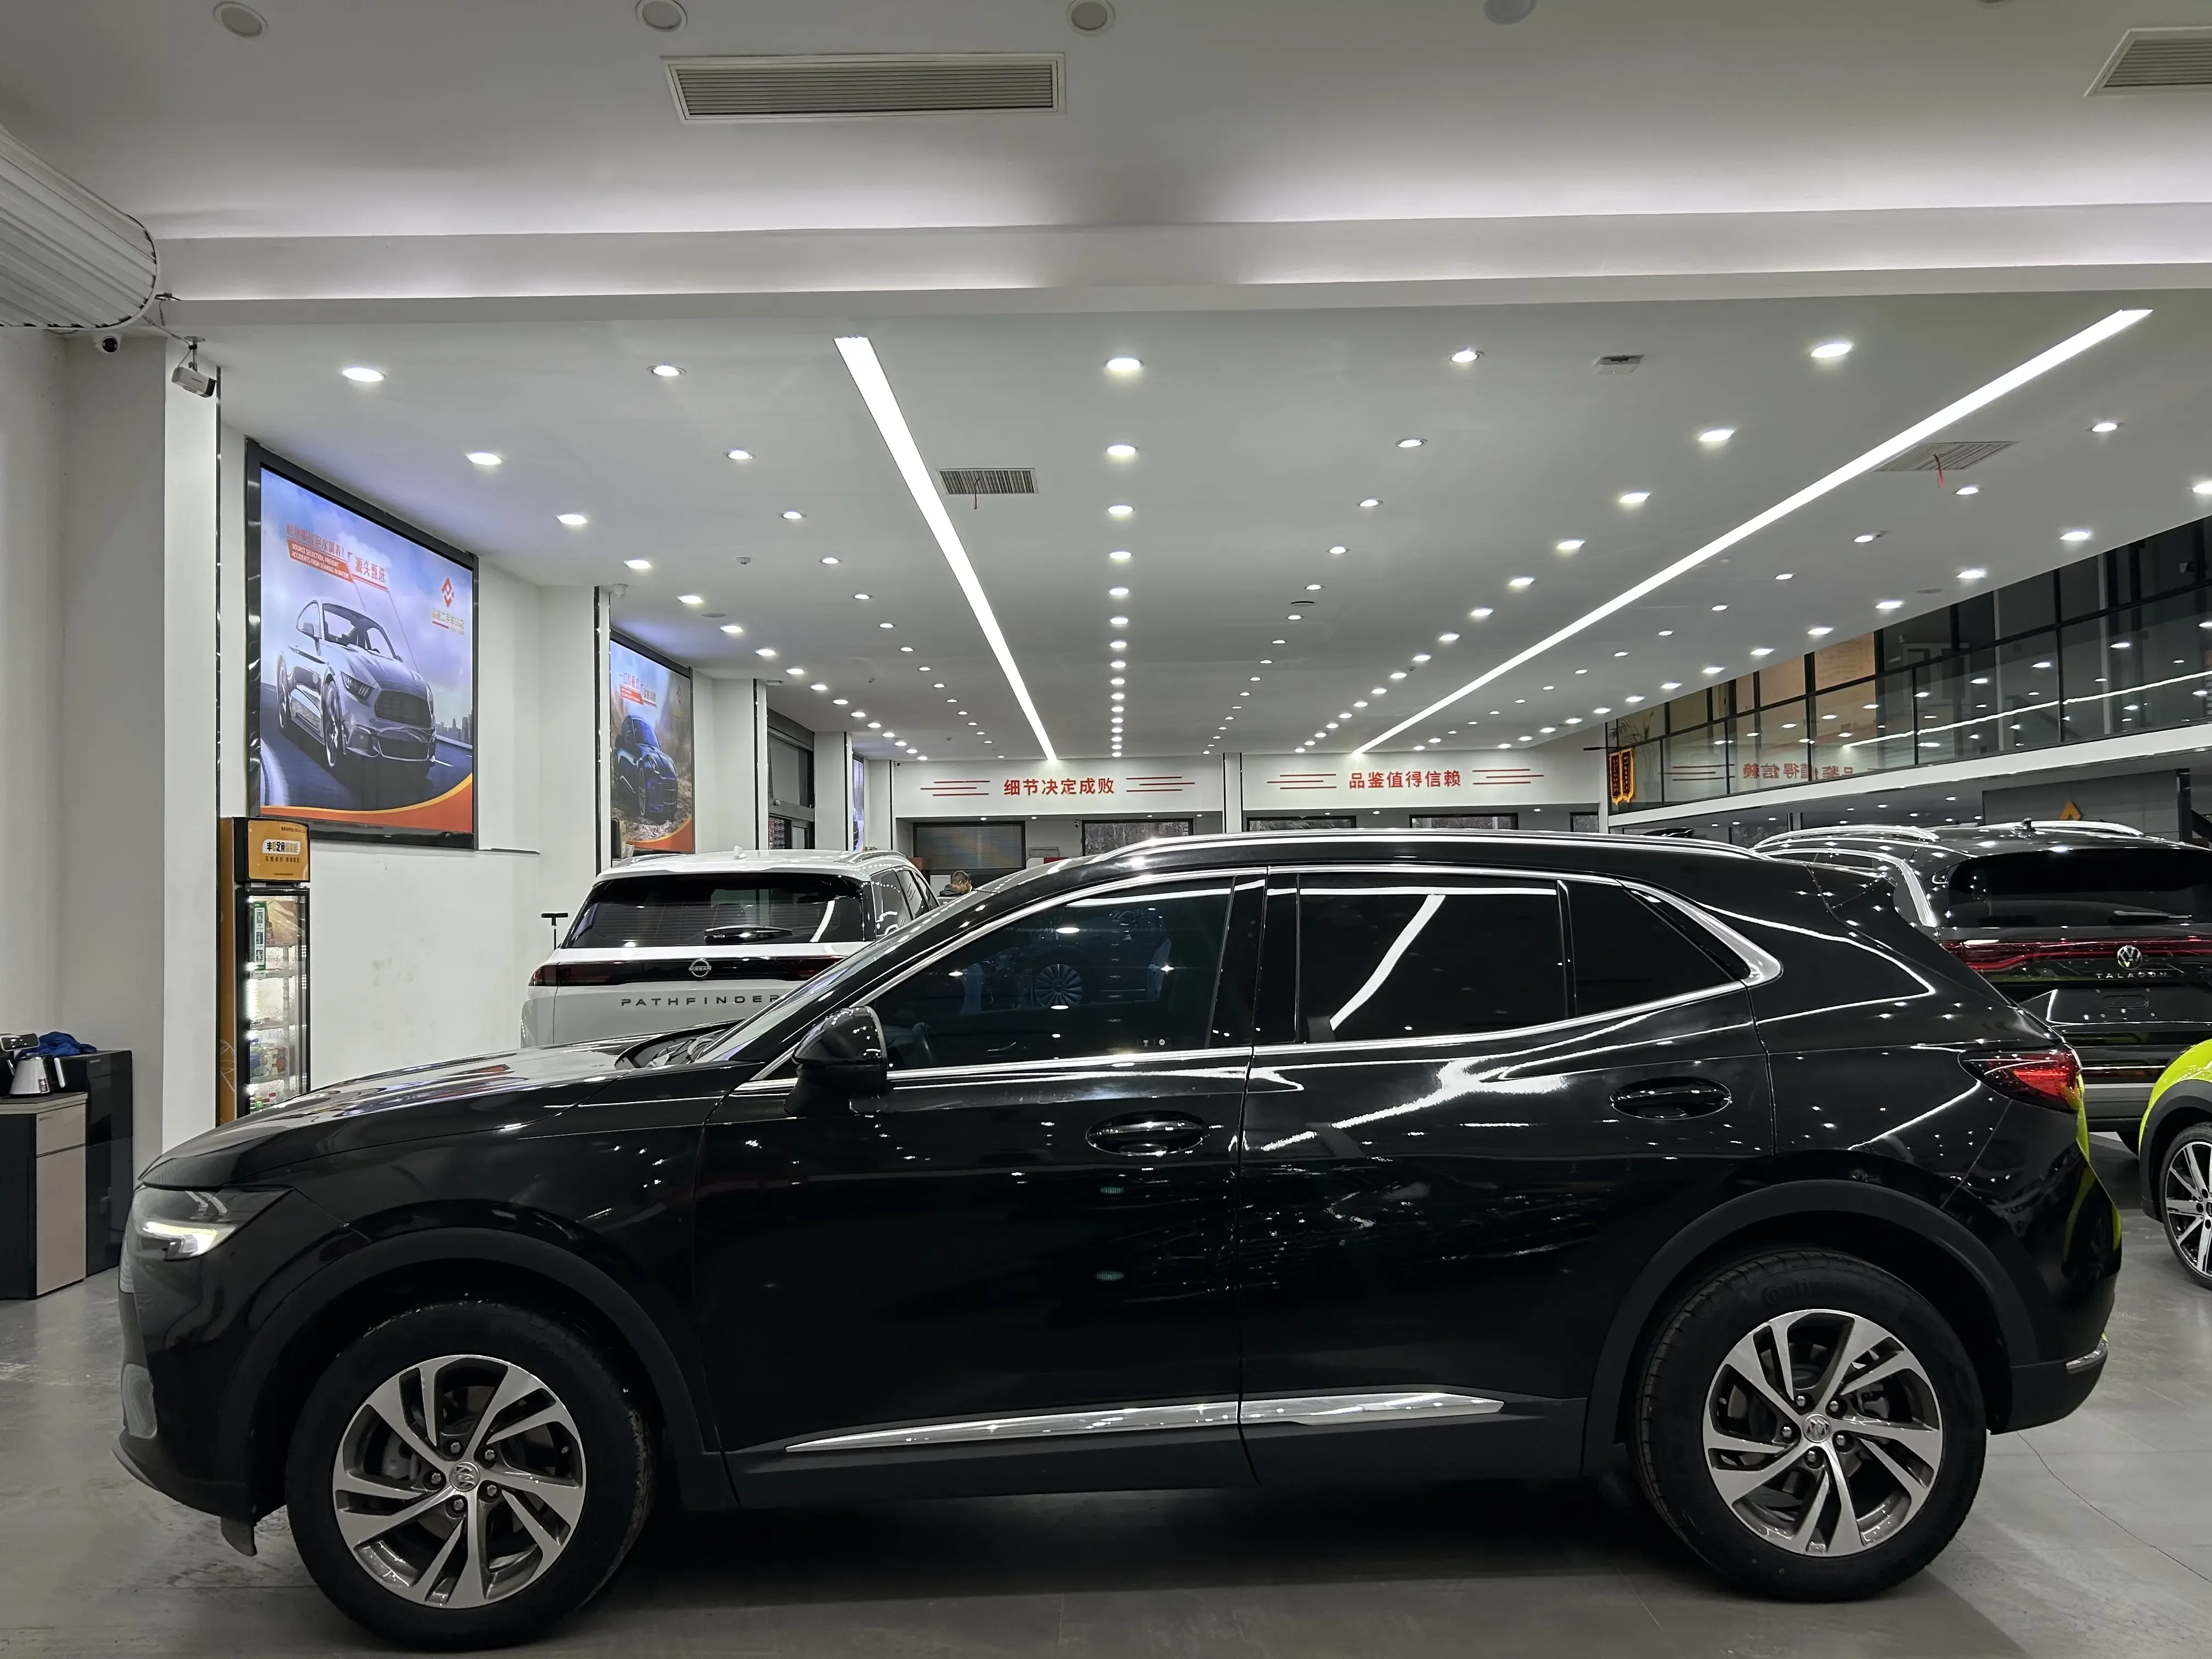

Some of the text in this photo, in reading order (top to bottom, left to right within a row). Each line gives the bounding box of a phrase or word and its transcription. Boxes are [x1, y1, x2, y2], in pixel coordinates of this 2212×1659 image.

[1004, 777, 1114, 795] 细节决定成败
[1349, 770, 1461, 789] 品鉴值得信赖
[621, 995, 782, 1007] PATHFINDER
